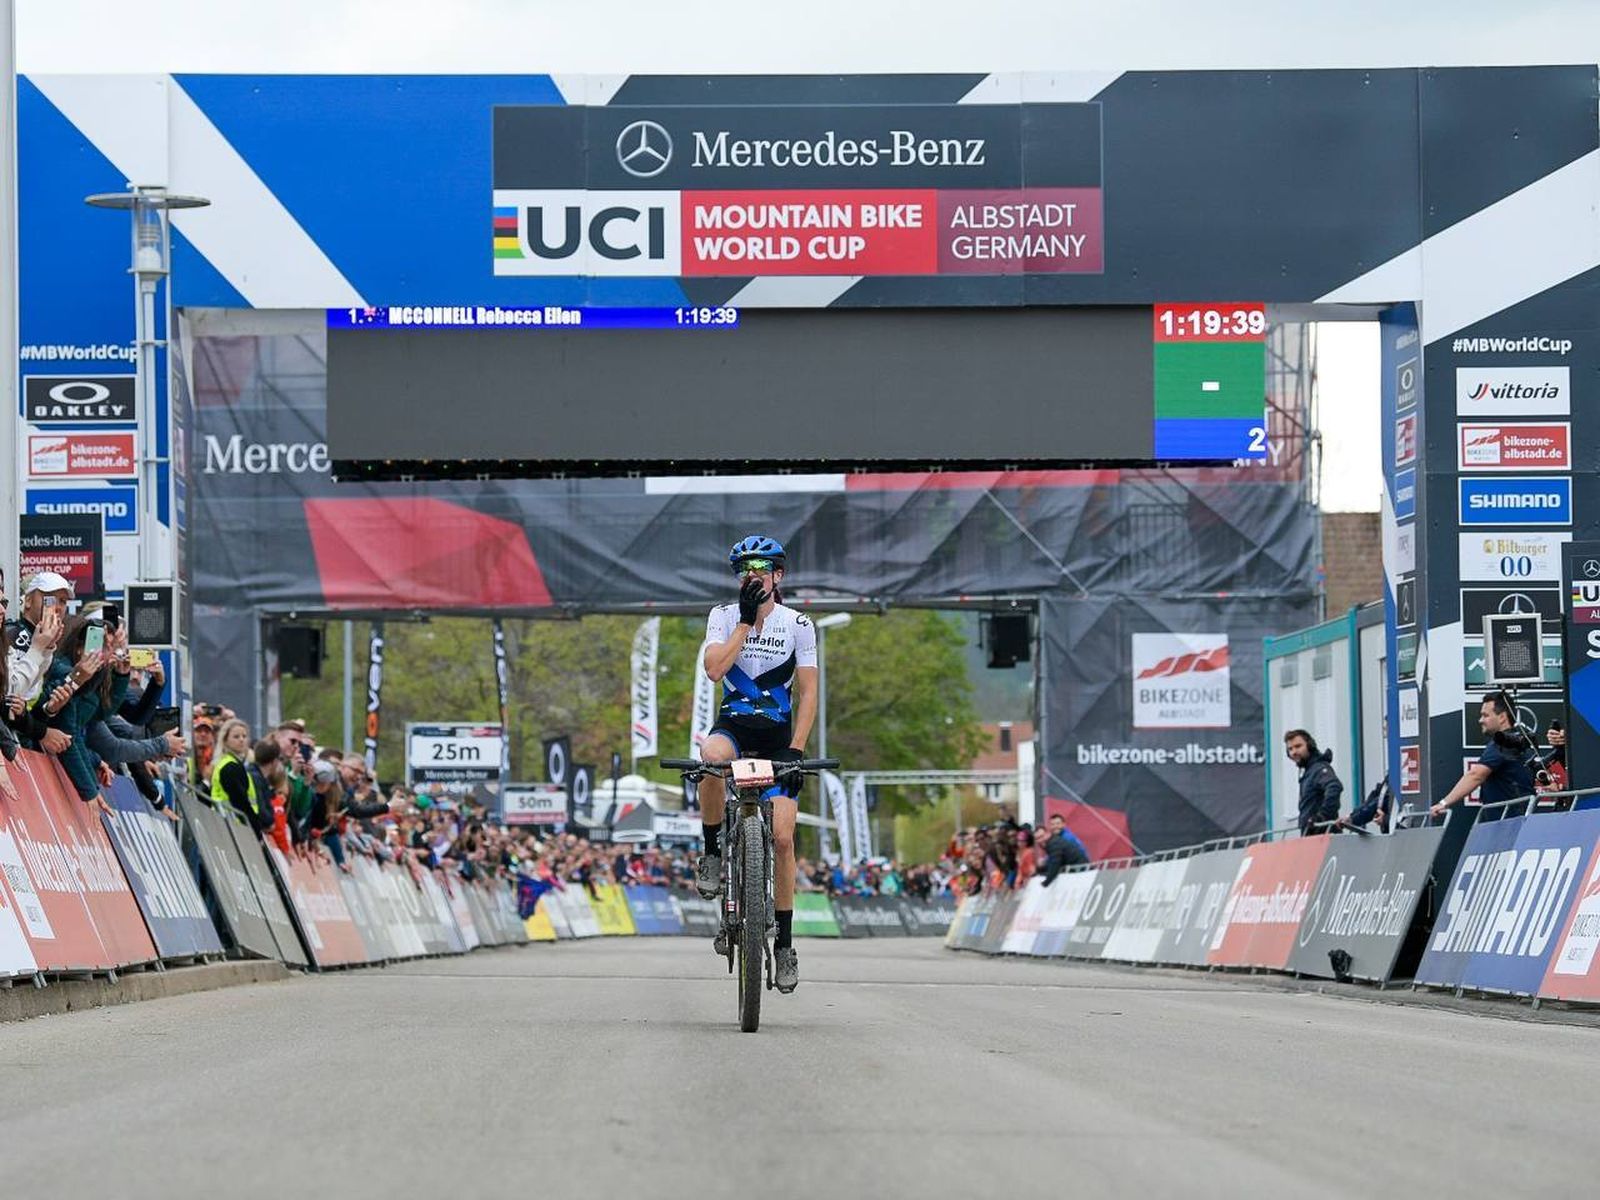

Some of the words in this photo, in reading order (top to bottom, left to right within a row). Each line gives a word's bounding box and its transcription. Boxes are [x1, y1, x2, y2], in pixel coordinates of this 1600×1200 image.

[692, 131, 985, 168] Mercedes-Benz
[694, 205, 853, 229] MOUNTAIN
[861, 204, 922, 228] BIKE
[951, 203, 1076, 229] ALBSTADT
[526, 206, 665, 260] UCI
[694, 237, 798, 260] WORLD
[804, 236, 866, 260] CUP
[951, 234, 1086, 260] GERMANY
[389, 307, 475, 325] MCCONNELL
[674, 308, 738, 325] 1:19:39
[1160, 310, 1266, 336] 1:19:39
[20, 344, 138, 363] #MBWorldCup
[1452, 337, 1572, 355] #MBWorldCup
[1490, 382, 1560, 400] vittoria
[34, 404, 124, 417] OAKLEY
[1247, 427, 1267, 452] 2
[1503, 435, 1554, 447] bikezone-
[204, 434, 332, 474] Merce
[1503, 448, 1563, 460] albstadt.de
[1469, 493, 1561, 508] SHIMANO
[20, 555, 68, 565] MOUNTAIN
[69, 555, 89, 565] BIKE
[1500, 555, 1532, 577] 0.0
[1139, 688, 1224, 704] BIKEZONE
[431, 743, 481, 761] 25m
[1077, 744, 1265, 765] bikezone-albstadt.
[747, 762, 757, 774] 1
[518, 796, 553, 809] 50m
[1321, 872, 1417, 937] Mercedes-Benz
[1431, 846, 1582, 958] SHIMANO
